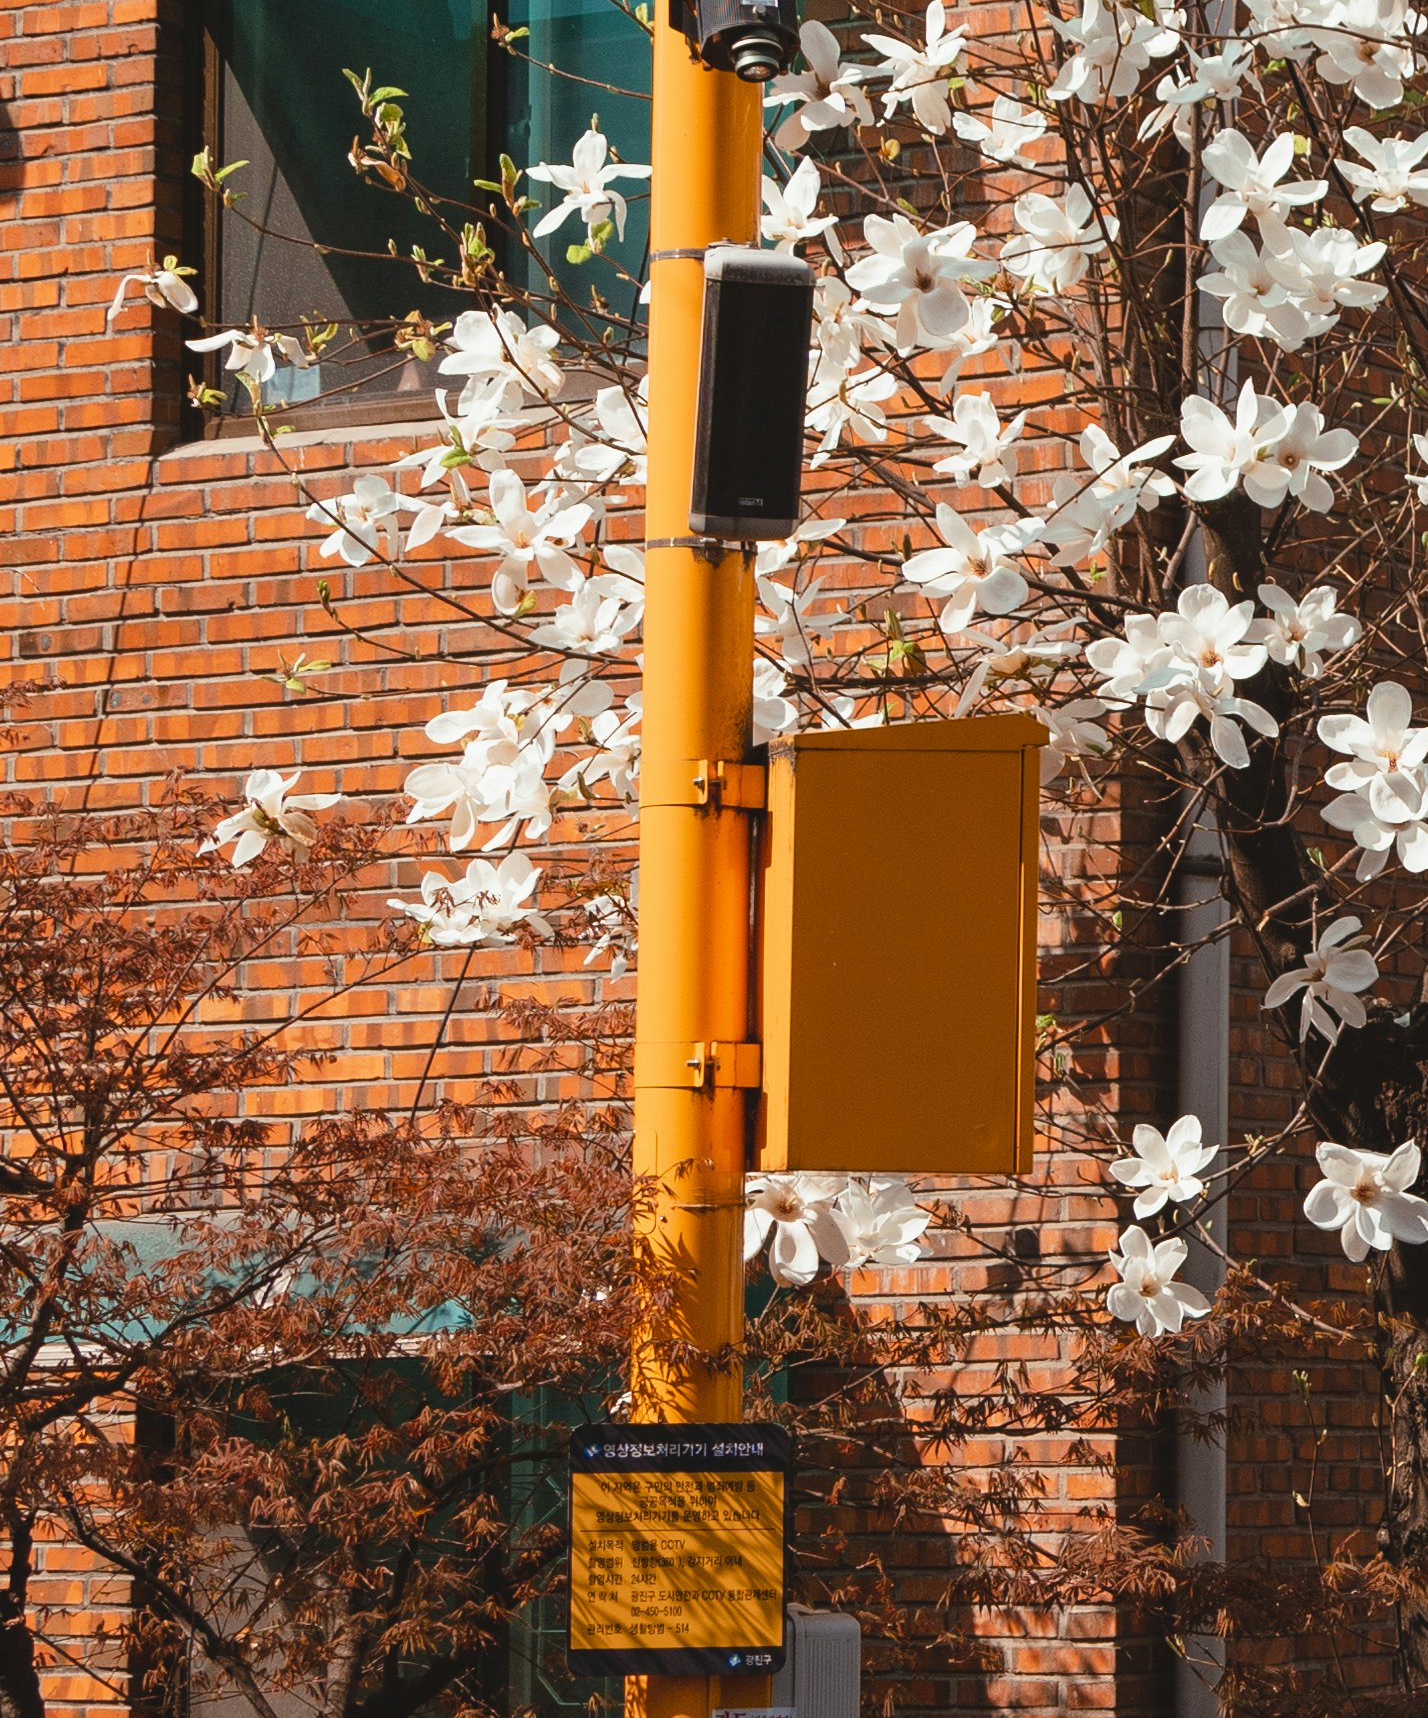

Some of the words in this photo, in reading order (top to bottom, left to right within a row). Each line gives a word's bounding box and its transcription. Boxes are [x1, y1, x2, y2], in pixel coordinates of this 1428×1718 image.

[603, 1443, 707, 1458] 영상정보처리기기
[712, 1442, 764, 1457] 설치안내
[588, 1540, 624, 1552] 설치목적
[661, 1540, 685, 1550] CCTV
[631, 1591, 654, 1602] 광진구
[702, 1590, 725, 1601] CCTV
[676, 1624, 689, 1634] 514
[745, 1654, 772, 1666] 광진구
